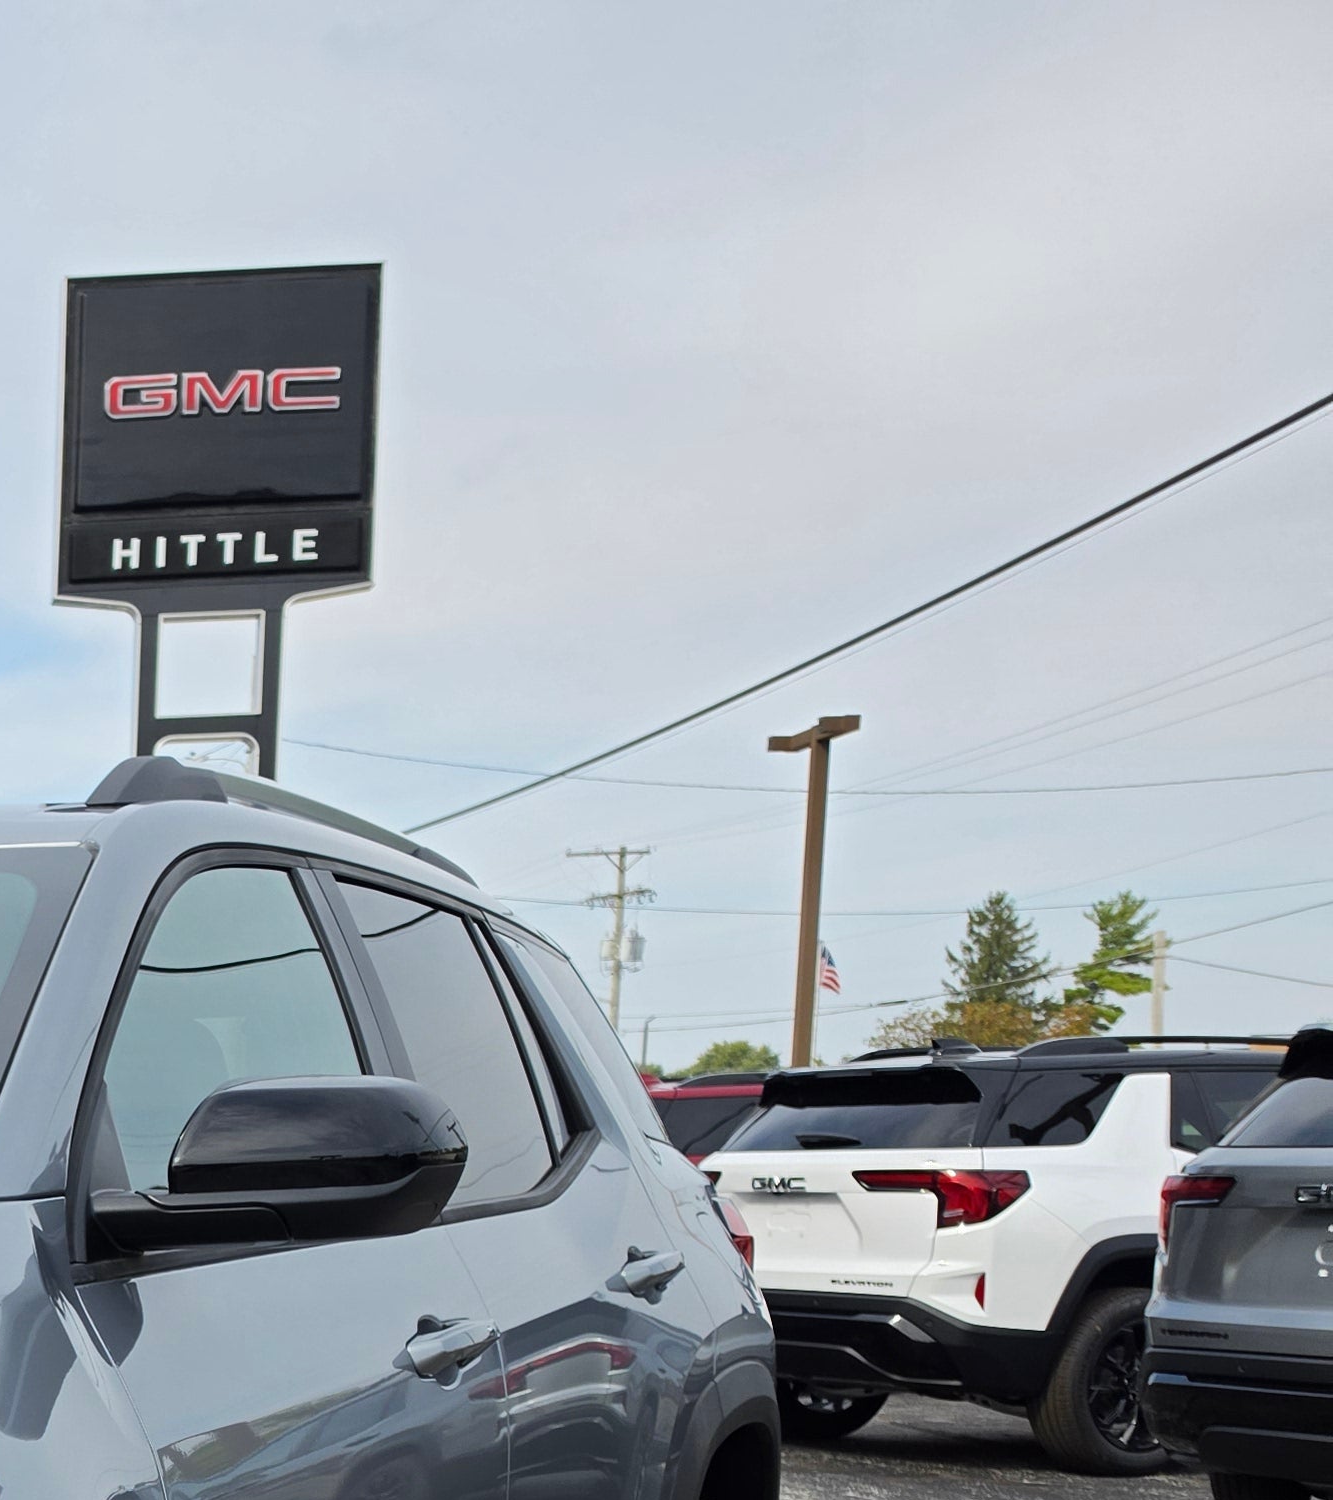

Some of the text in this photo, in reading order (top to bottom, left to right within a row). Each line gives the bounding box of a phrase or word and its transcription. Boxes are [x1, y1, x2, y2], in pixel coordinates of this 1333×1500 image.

[104, 366, 341, 420] GMC
[111, 527, 319, 571] HITTLE
[751, 1177, 805, 1191] GMC
[830, 1279, 894, 1288] ELEVATION
